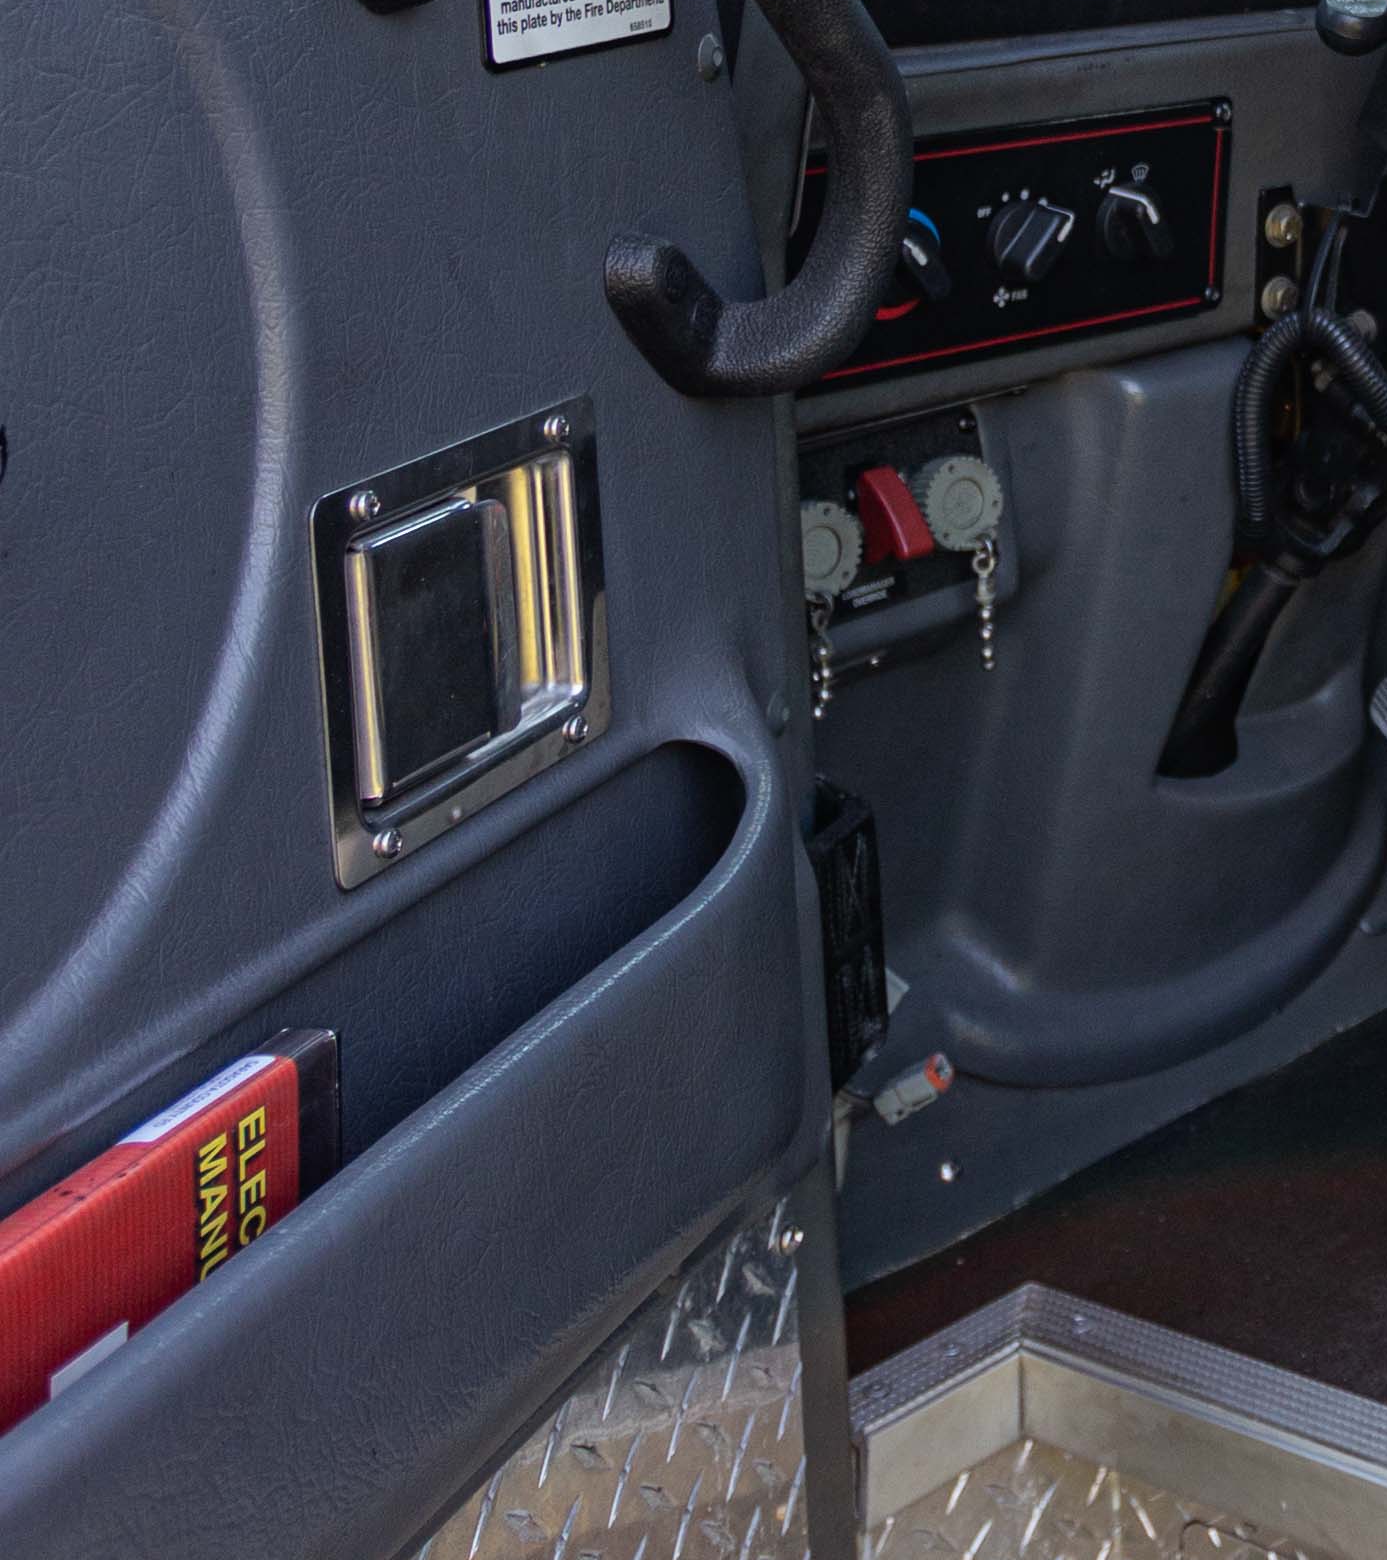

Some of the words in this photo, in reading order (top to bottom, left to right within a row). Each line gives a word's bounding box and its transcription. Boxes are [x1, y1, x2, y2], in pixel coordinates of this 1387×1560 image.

[497, 20, 519, 35] this
[521, 14, 547, 34] plate
[550, 12, 563, 28] by
[565, 8, 581, 22] the
[584, 3, 604, 18] Fire
